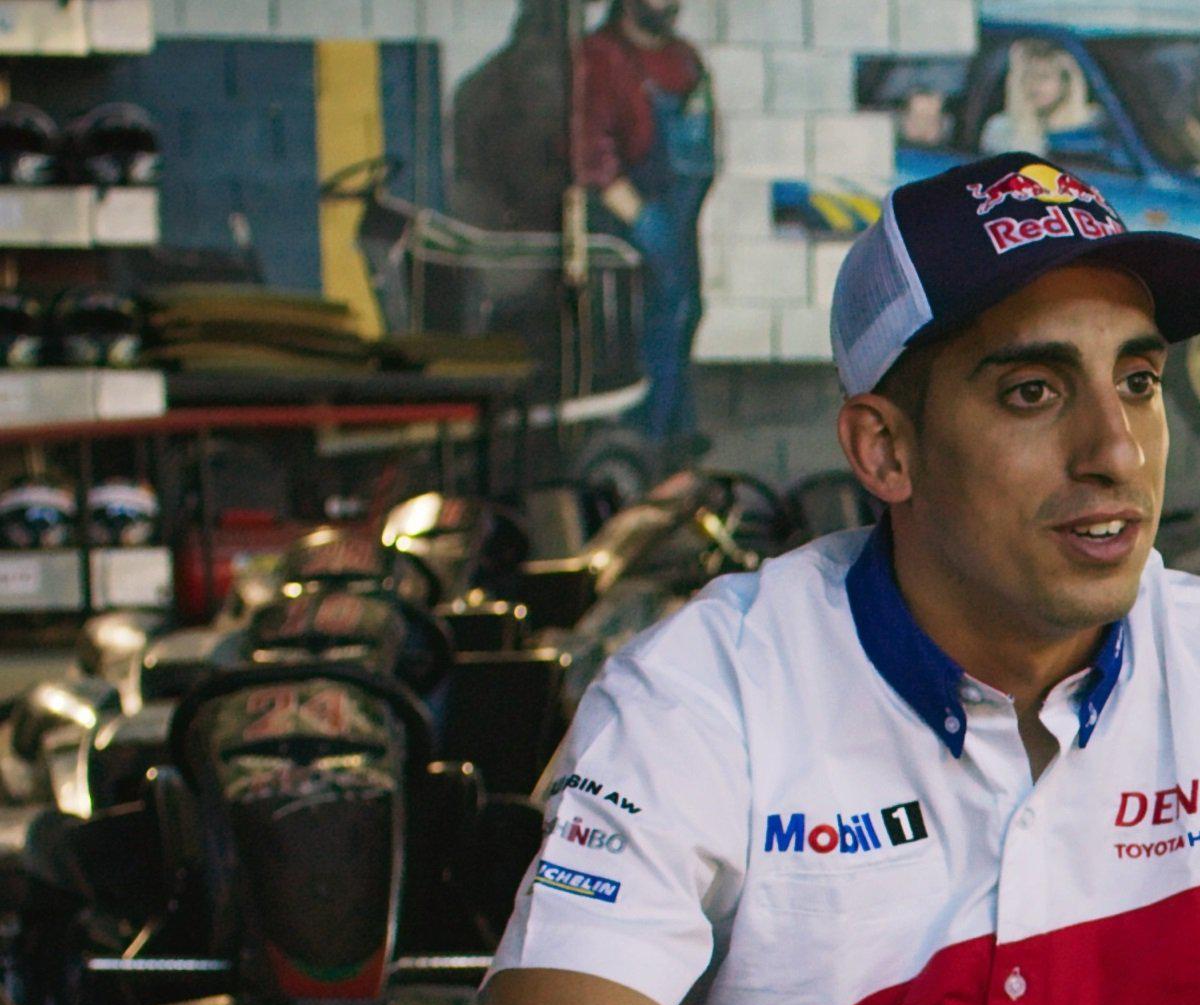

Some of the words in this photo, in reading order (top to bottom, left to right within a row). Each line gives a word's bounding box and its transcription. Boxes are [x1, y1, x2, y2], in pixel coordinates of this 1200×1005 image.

[984, 206, 1074, 255] Red
[603, 791, 642, 814] AW
[764, 813, 882, 854] Mobil
[1114, 835, 1186, 859] TOYOTA
[538, 864, 617, 897] ICHELIN
